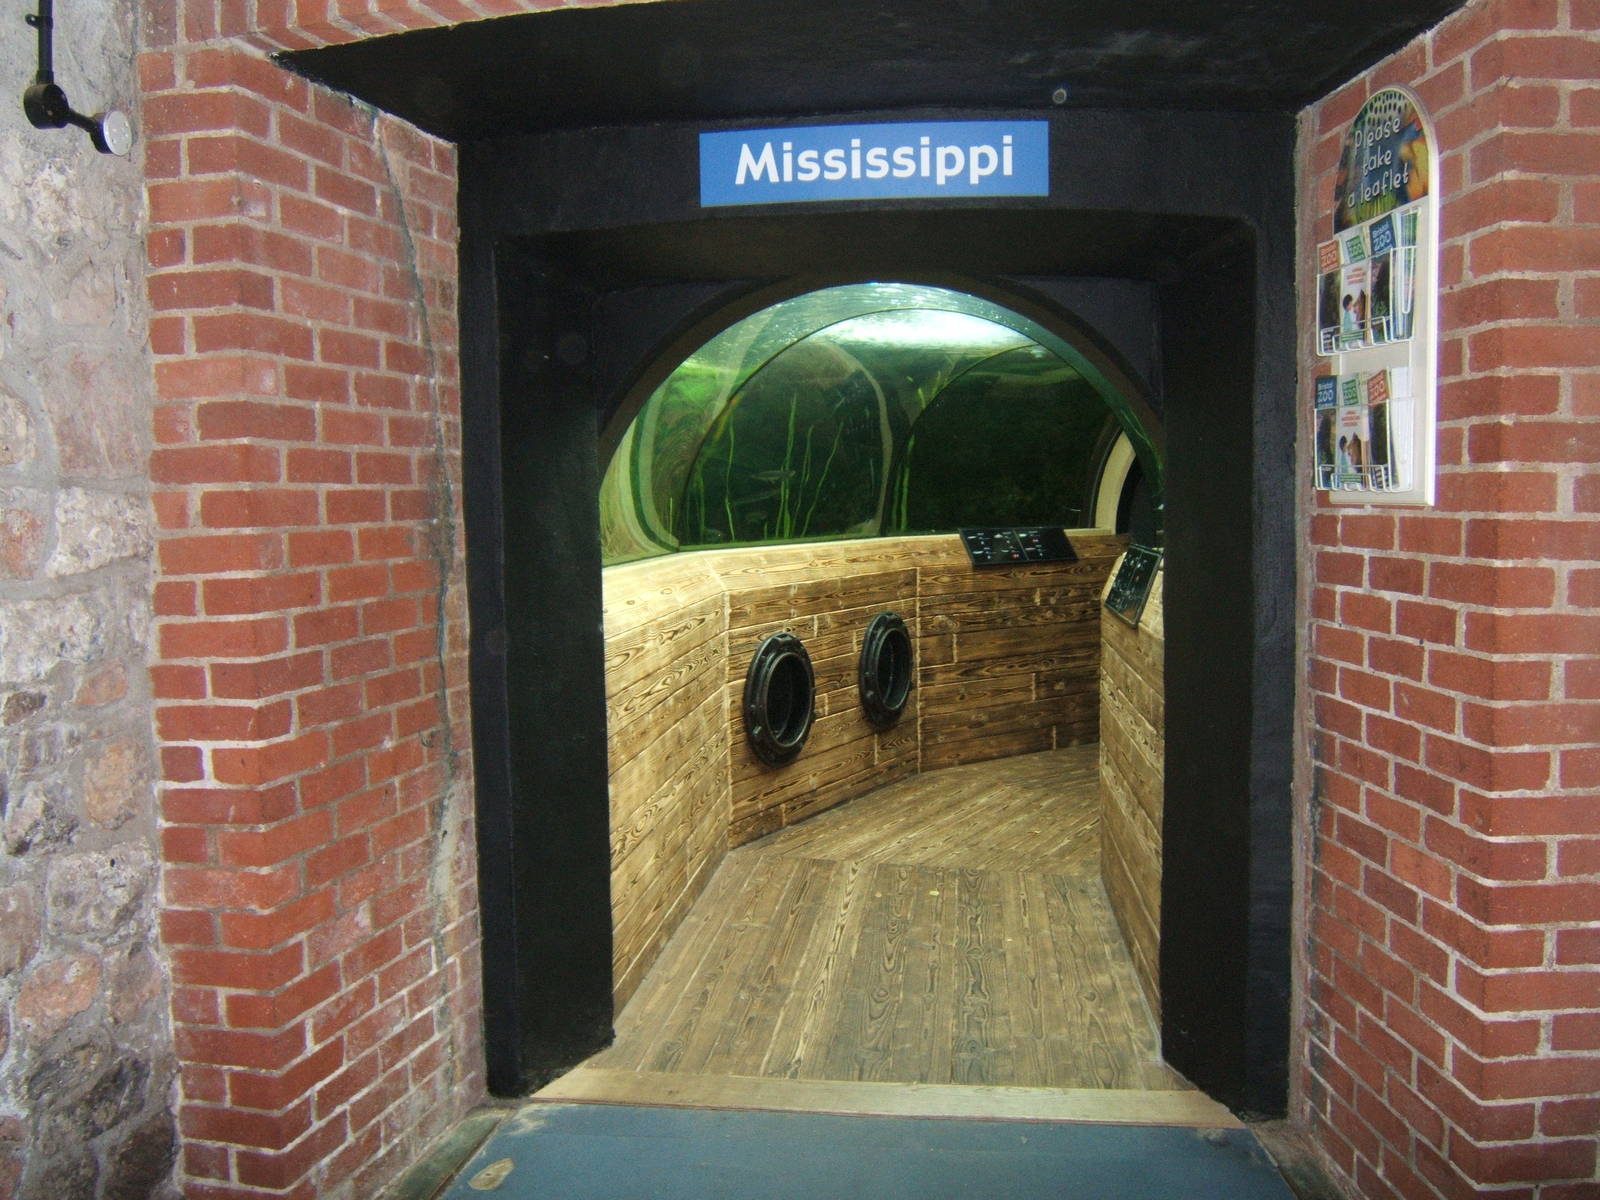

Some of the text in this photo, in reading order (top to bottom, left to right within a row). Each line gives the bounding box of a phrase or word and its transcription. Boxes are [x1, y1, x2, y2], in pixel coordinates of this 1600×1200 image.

[735, 135, 1013, 185] Mississippi
[1363, 144, 1392, 176] take
[1348, 162, 1409, 207] a leaflet
